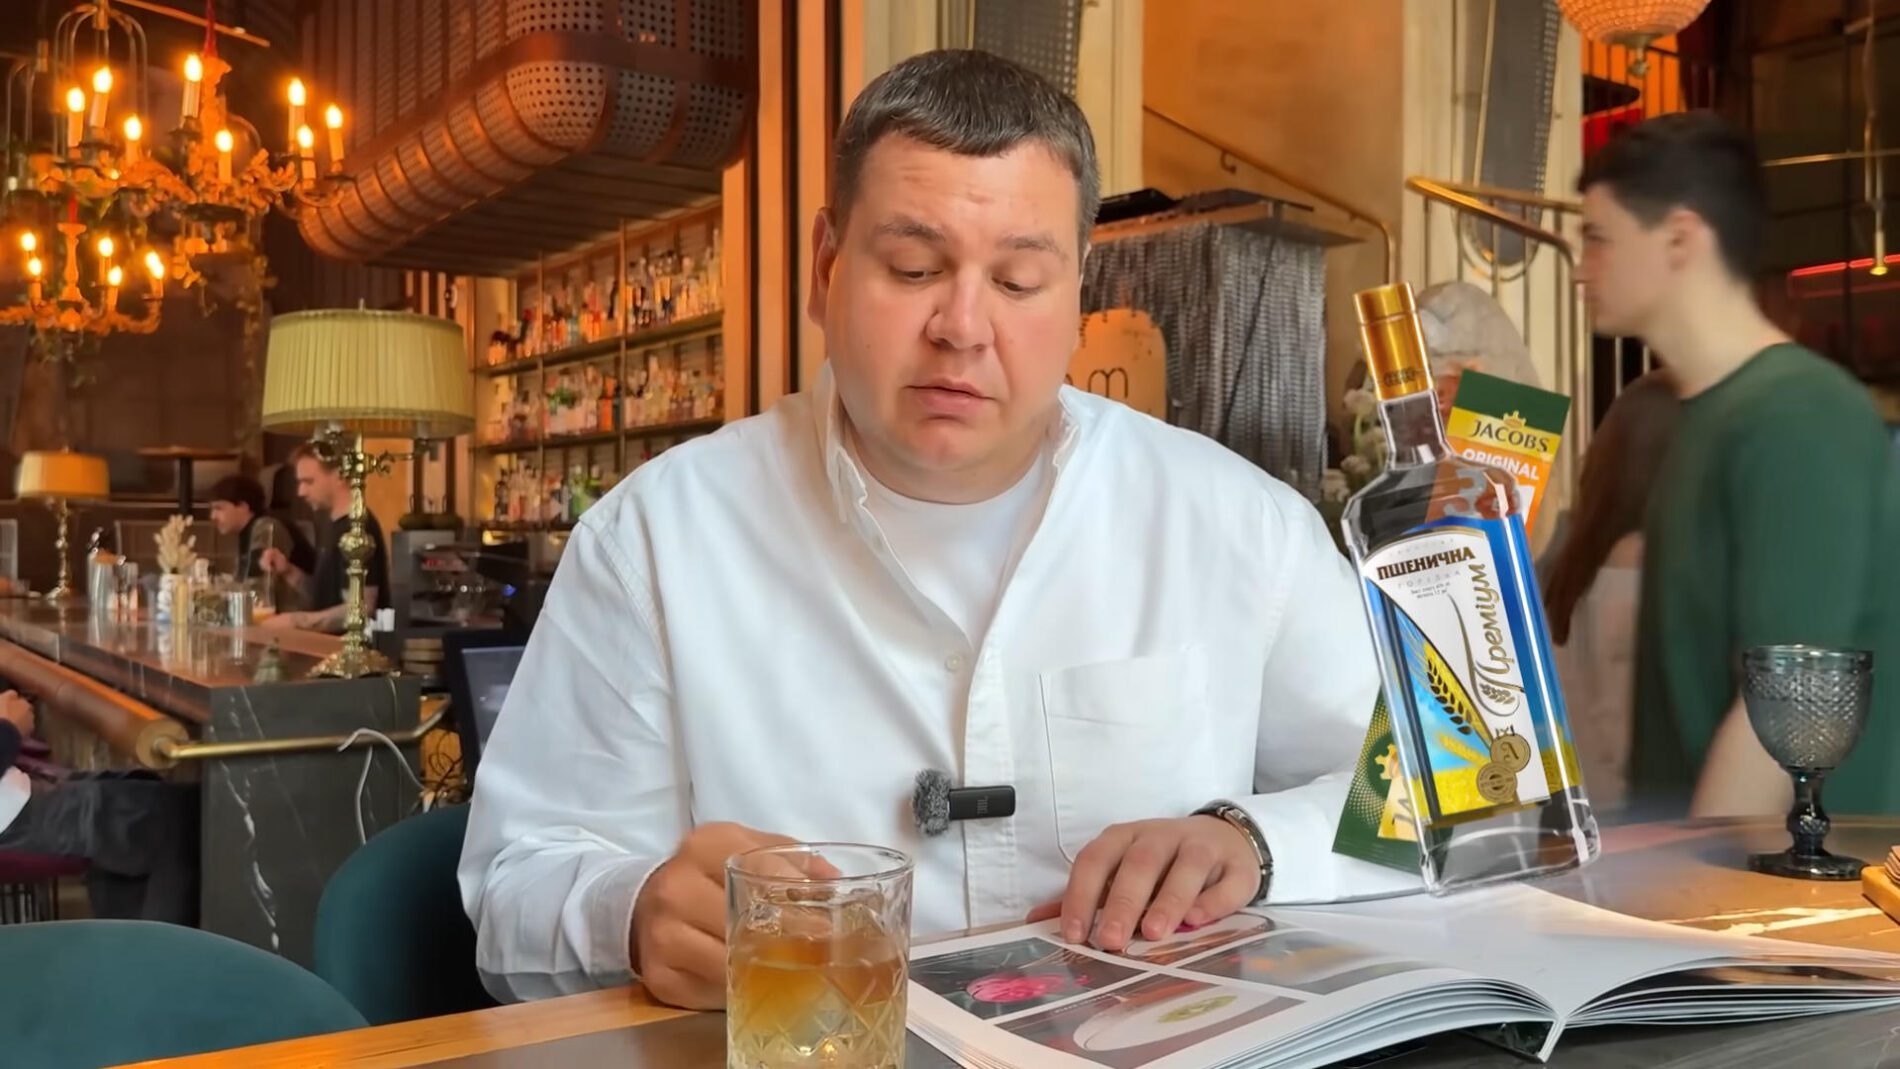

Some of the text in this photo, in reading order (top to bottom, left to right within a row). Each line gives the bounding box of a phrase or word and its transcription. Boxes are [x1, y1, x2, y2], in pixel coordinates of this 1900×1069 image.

[1468, 419, 1550, 453] JACOBS
[1461, 447, 1540, 481] ORIGINAL
[1376, 546, 1476, 580] ПШЕНИЧНА
